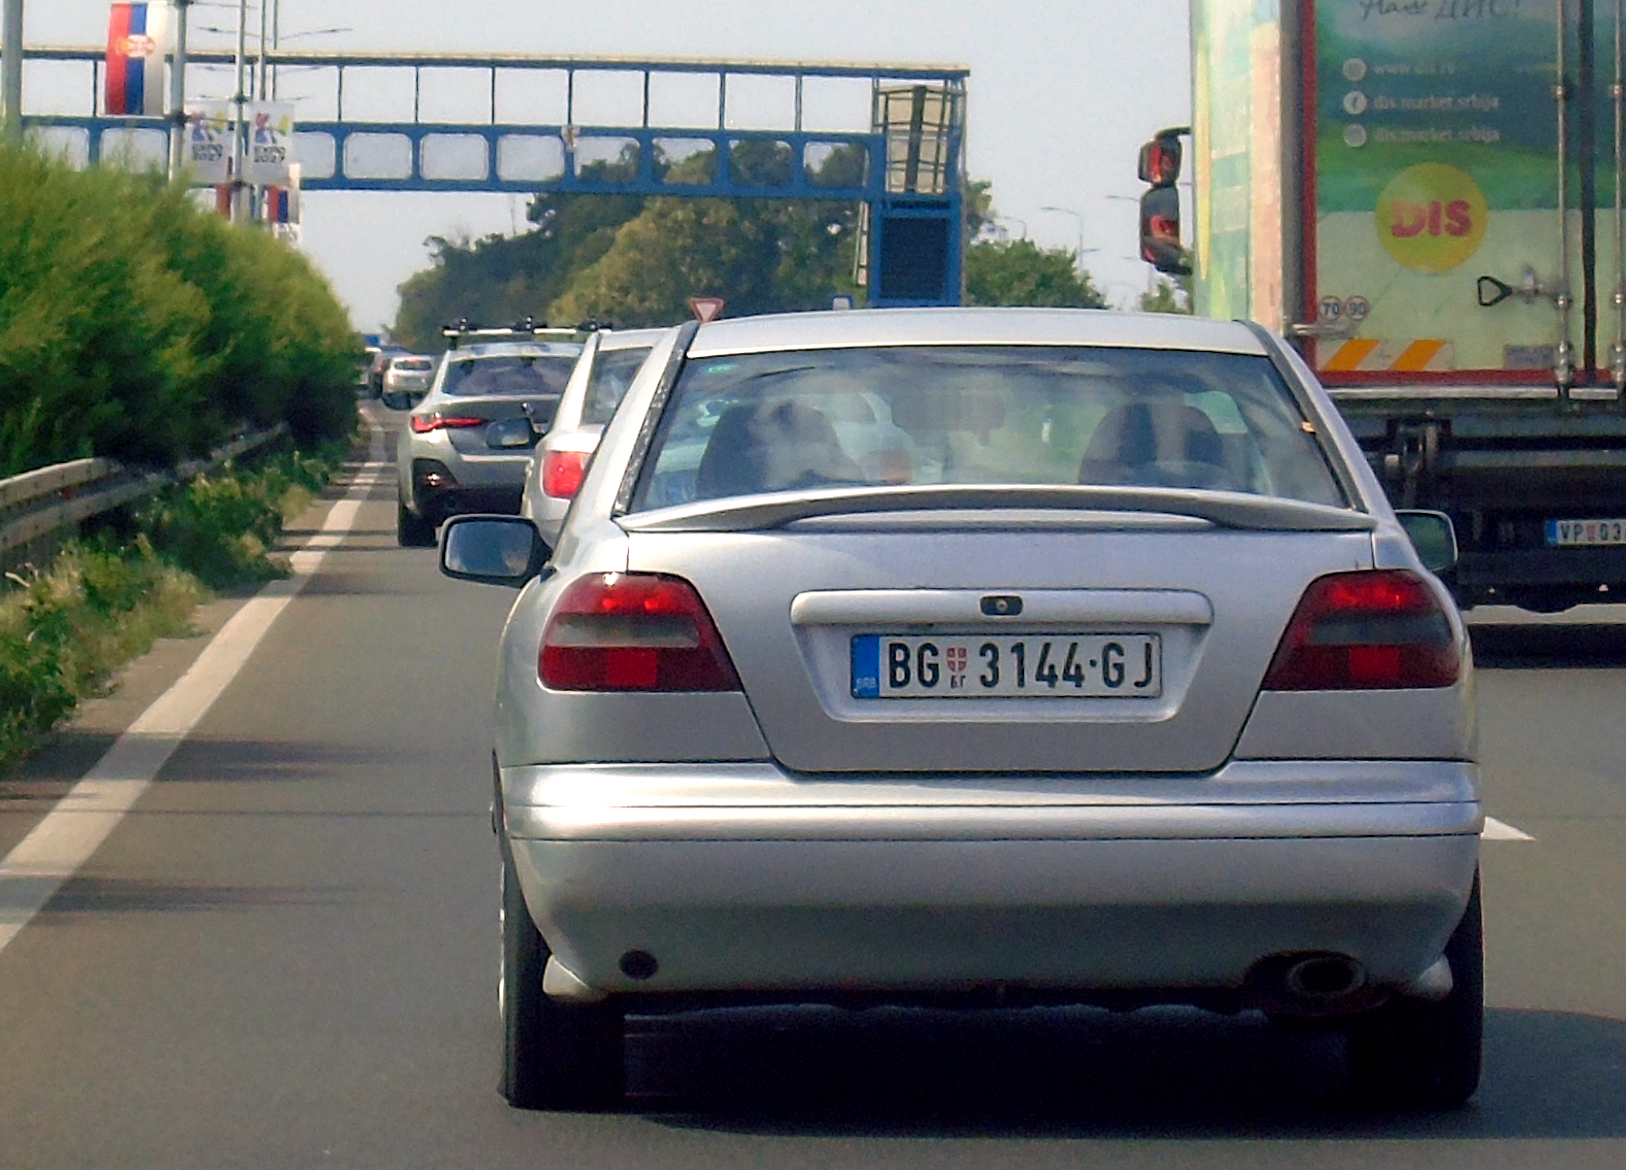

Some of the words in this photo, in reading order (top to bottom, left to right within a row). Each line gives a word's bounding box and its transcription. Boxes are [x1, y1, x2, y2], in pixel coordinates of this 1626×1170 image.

[1390, 200, 1472, 238] DIS
[1323, 302, 1340, 315] 70
[1349, 302, 1367, 315] 90
[1561, 523, 1584, 542] VP
[888, 642, 940, 688] BG
